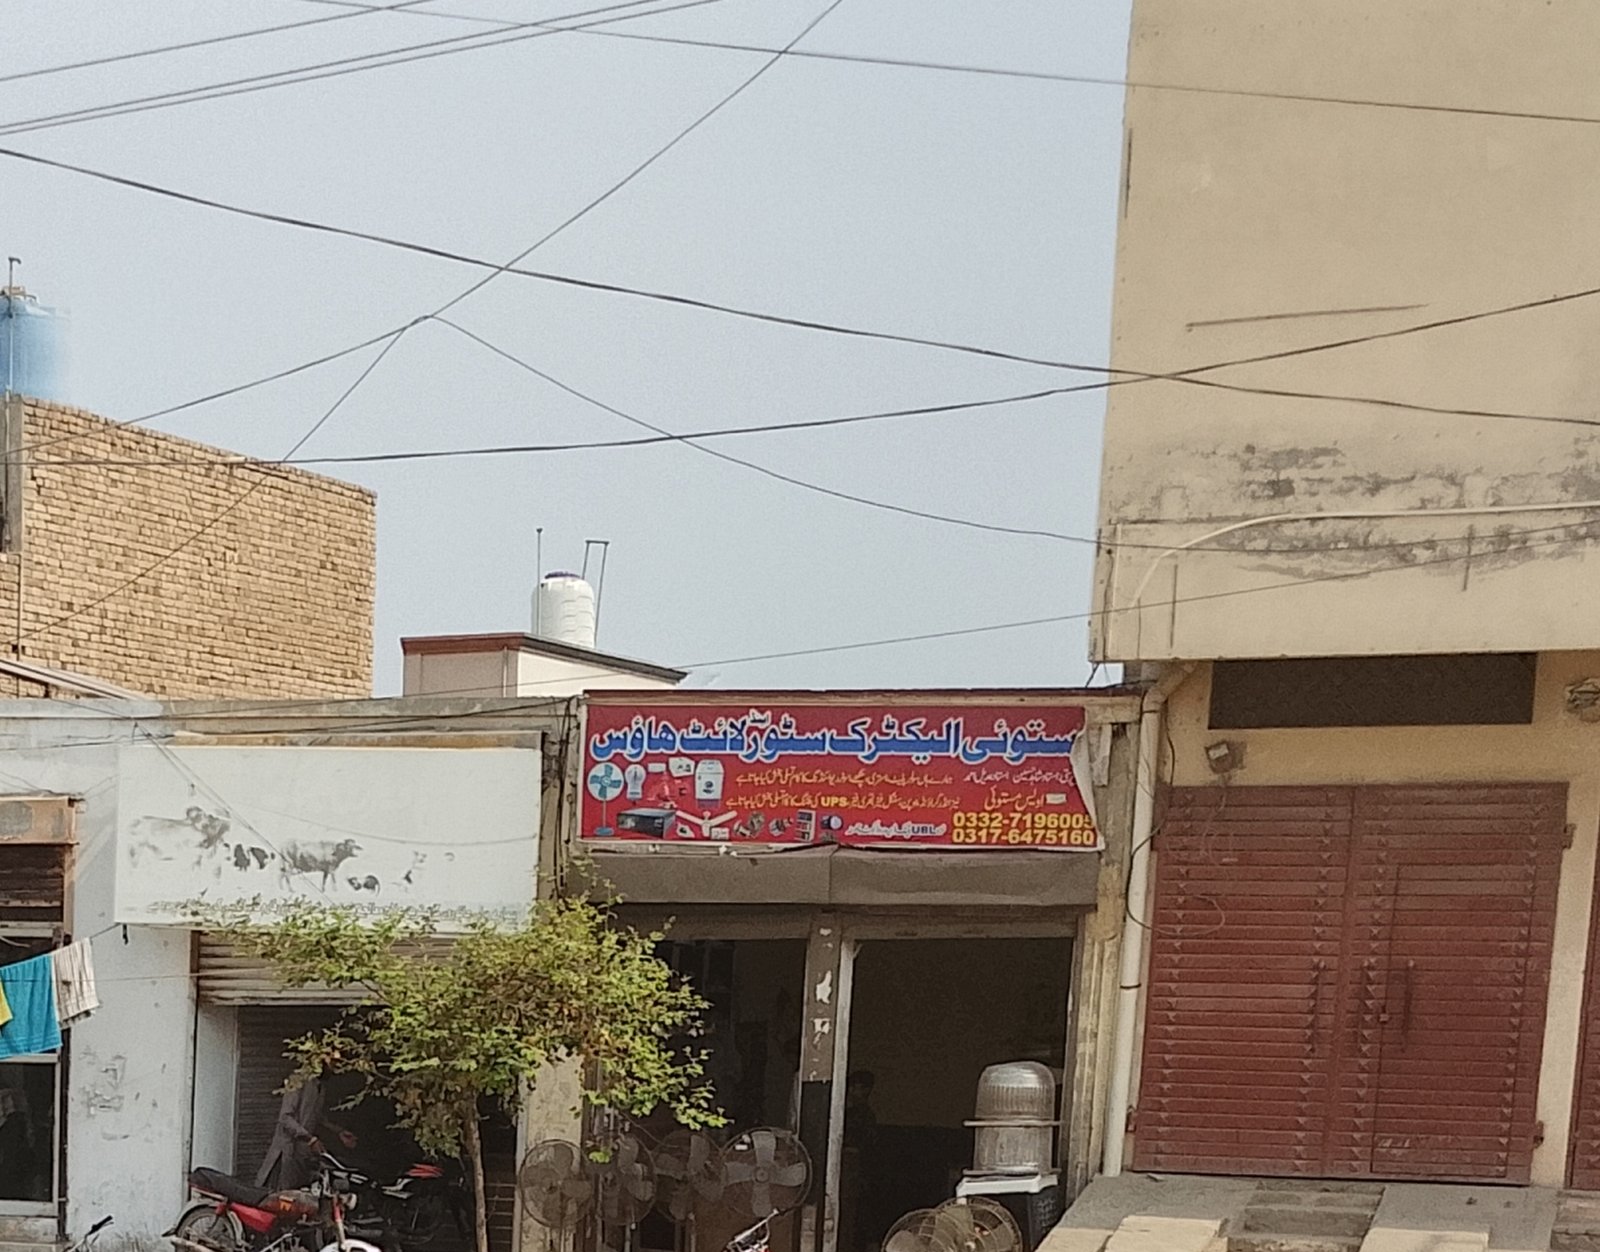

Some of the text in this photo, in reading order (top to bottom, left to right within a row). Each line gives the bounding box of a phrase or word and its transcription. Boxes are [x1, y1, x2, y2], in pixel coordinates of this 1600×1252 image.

[679, 715, 748, 755] لائٹ
[739, 713, 827, 763] سٹور
[827, 713, 964, 765] الیکٹرک
[959, 718, 1077, 765] ستوئی
[820, 796, 848, 808] UPS
[911, 825, 936, 835] UBL
[952, 828, 1095, 845] 0317-6475160
